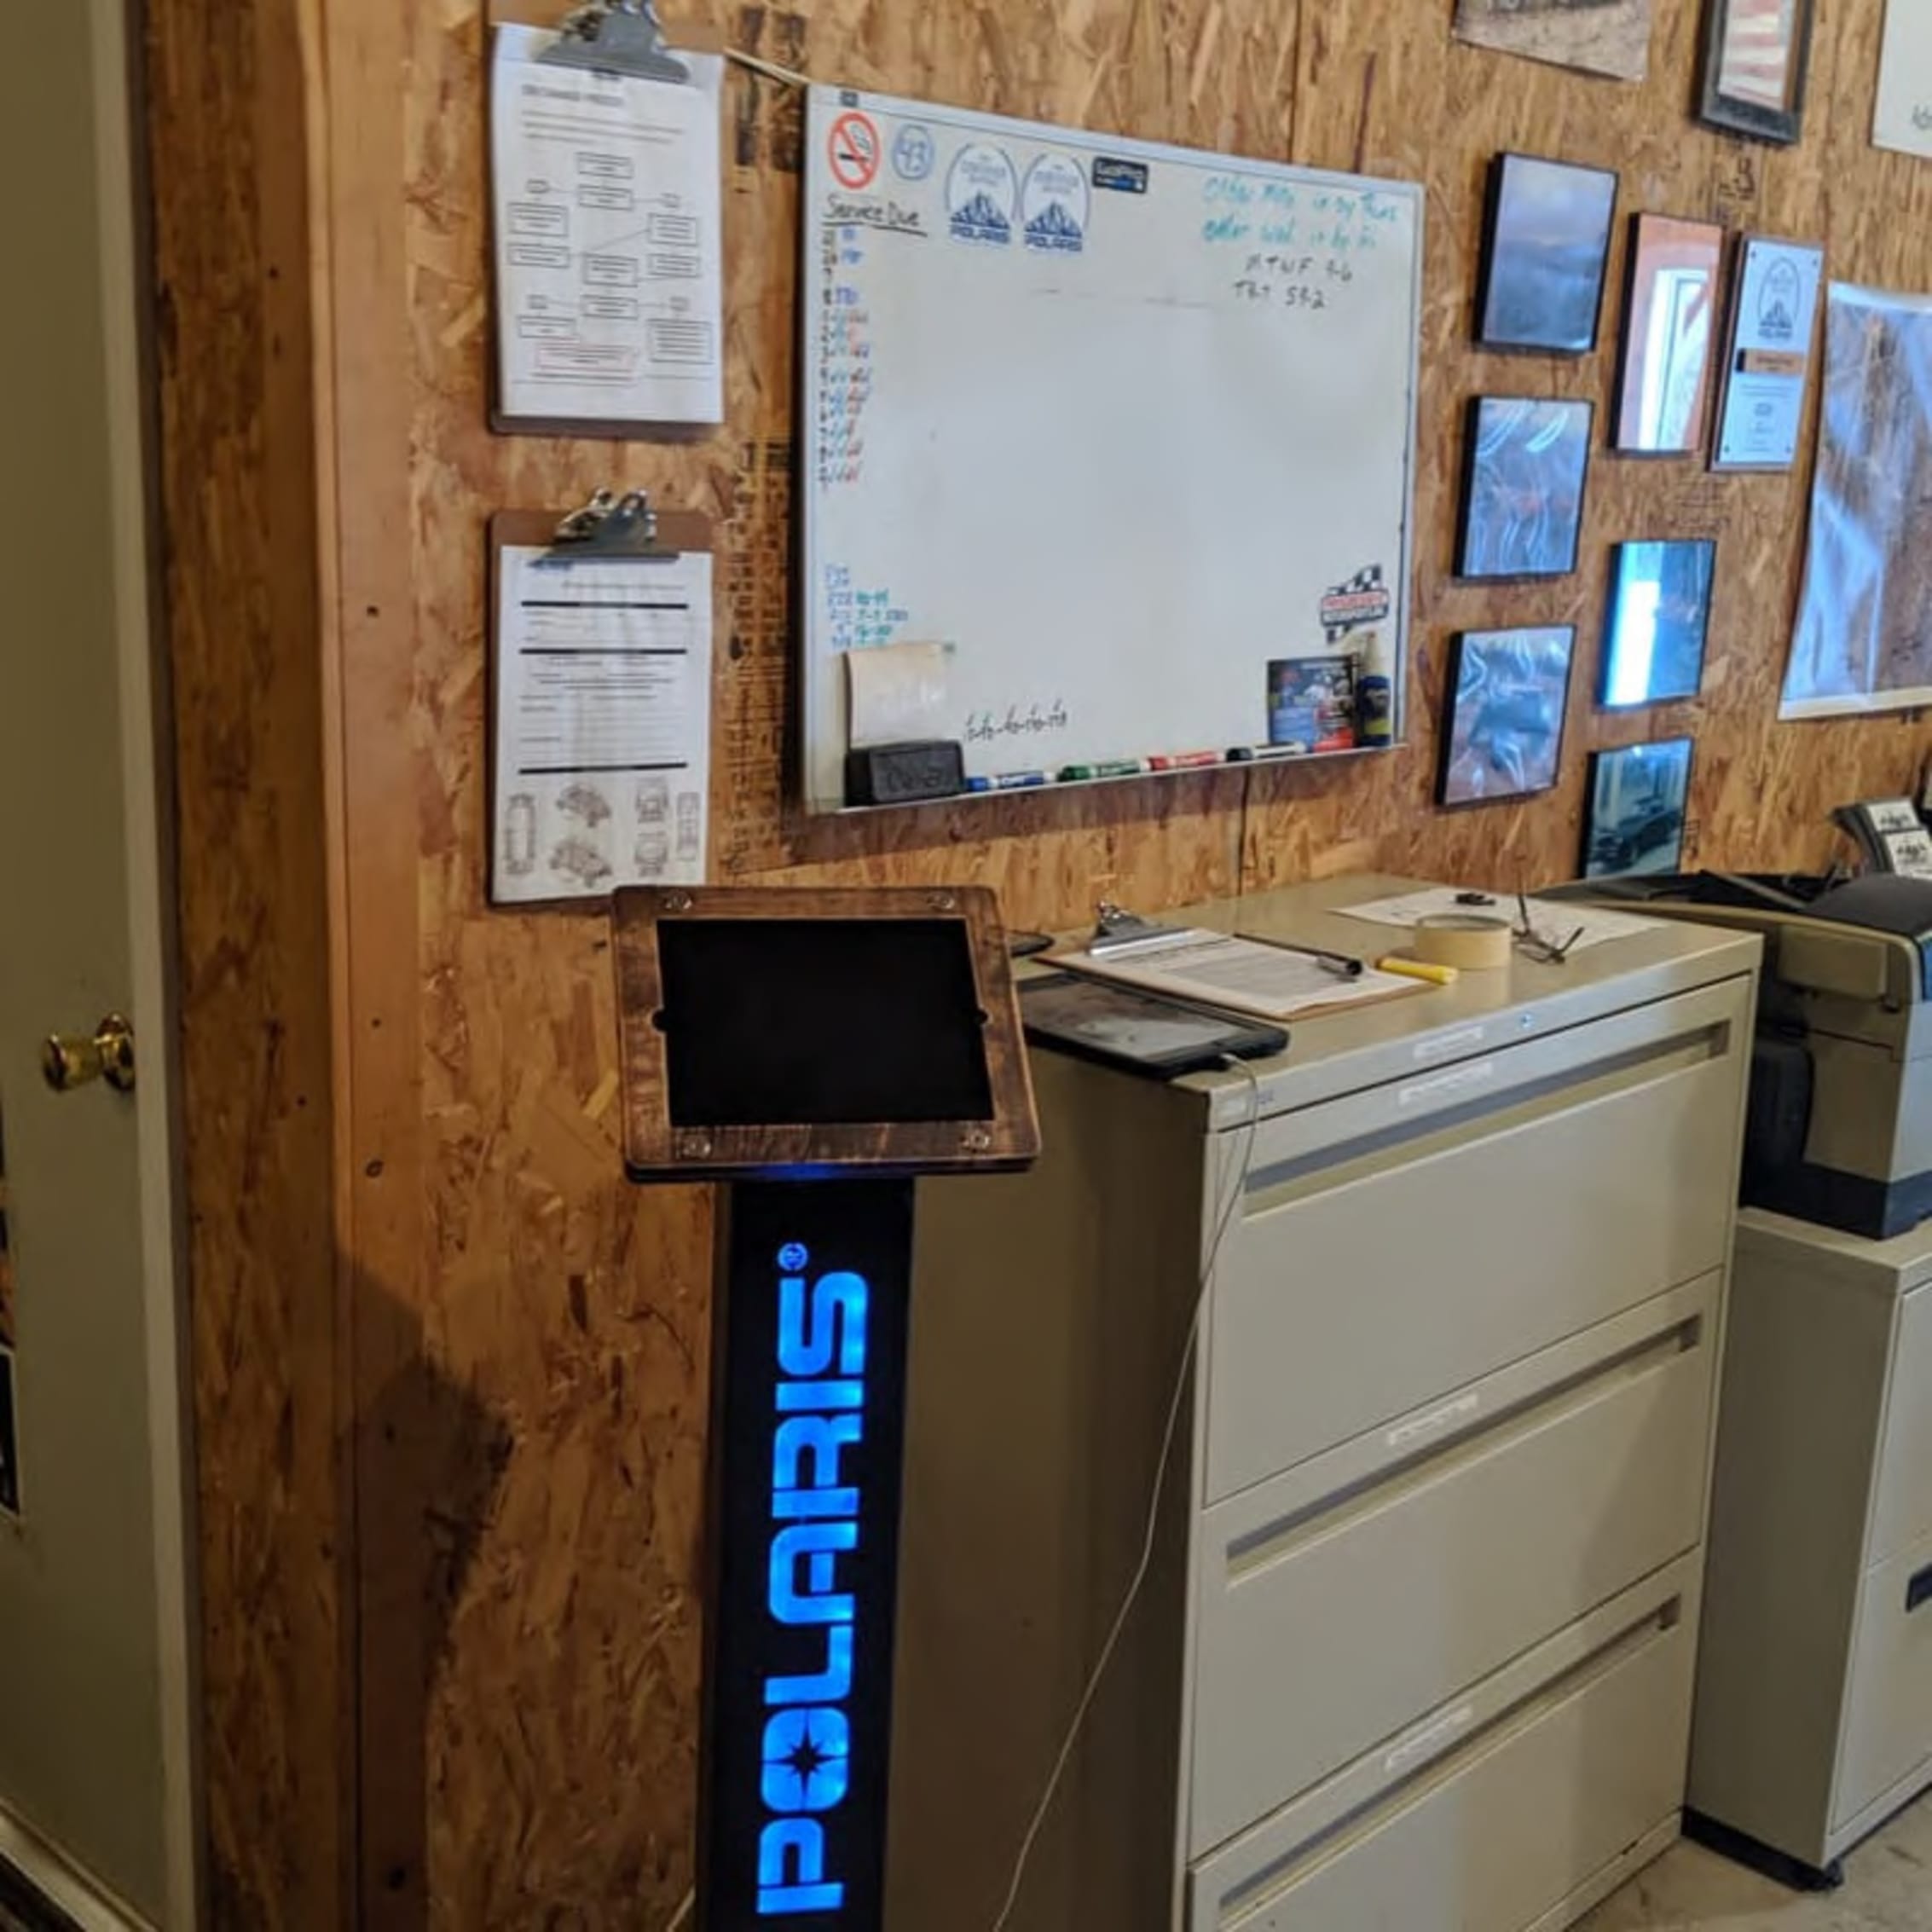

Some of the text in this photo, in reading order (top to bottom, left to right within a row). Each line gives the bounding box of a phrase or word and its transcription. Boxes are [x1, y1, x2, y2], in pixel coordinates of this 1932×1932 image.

[823, 193, 920, 226] Service Due
[950, 224, 1010, 245] POLARIS
[1025, 234, 1083, 252] POLARIS
[756, 1269, 870, 1915] POLARIS
